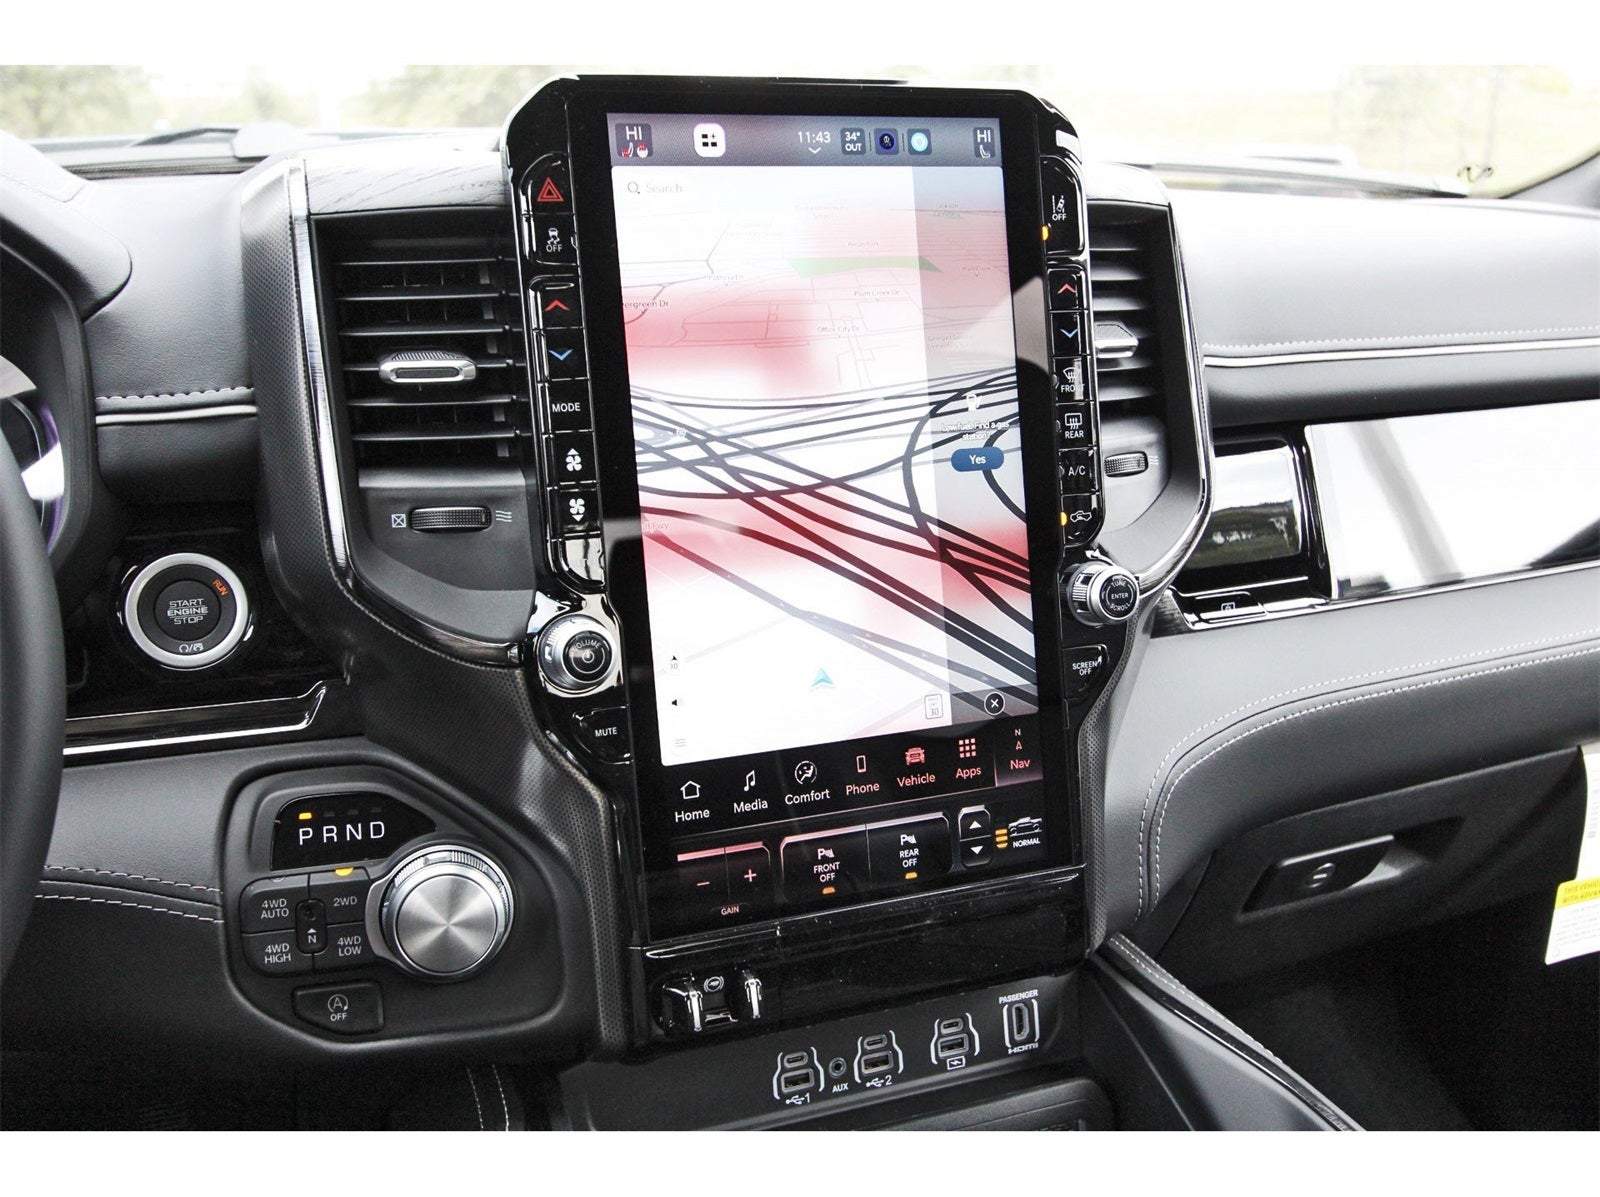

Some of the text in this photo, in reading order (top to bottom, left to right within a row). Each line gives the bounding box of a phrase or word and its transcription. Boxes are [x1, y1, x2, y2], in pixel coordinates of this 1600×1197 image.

[625, 126, 642, 140] HI
[798, 131, 831, 144] 11:43
[976, 129, 991, 142] HI
[845, 143, 862, 152] OUT
[645, 181, 683, 193] Search
[1052, 213, 1067, 221] OFF
[545, 244, 562, 253] OFF
[552, 402, 581, 413] MODE
[1064, 430, 1084, 440] REAR
[969, 454, 986, 464] Yes
[1068, 465, 1086, 476] A/C
[212, 579, 229, 596] RUN
[1111, 592, 1128, 600] ENTER
[169, 598, 204, 608] START
[167, 606, 208, 617] ENGINE
[173, 616, 204, 625] STOP
[1072, 660, 1098, 670] SCREEN
[1079, 668, 1092, 676] OFF
[595, 727, 617, 737] MUTE
[1014, 728, 1021, 736] N
[1010, 759, 1031, 770] Nav
[955, 767, 982, 779] Apps
[897, 773, 936, 787] Vehicle
[846, 782, 880, 796] Phone
[784, 788, 830, 805] Comfort
[733, 798, 769, 813] Media
[675, 809, 710, 822] Home
[299, 821, 385, 845] P R N D
[1012, 837, 1041, 848] NORMAL
[899, 848, 919, 859] REAR
[813, 861, 840, 874] FRONT
[902, 858, 917, 868] OFF
[819, 872, 836, 882] OFF
[261, 898, 287, 909] 4WD
[333, 896, 358, 906] 2WD
[261, 908, 289, 919] AUTO
[720, 904, 740, 915] GAIN
[308, 935, 317, 944] N
[337, 936, 361, 946] 4WD
[265, 943, 290, 954] 4WD
[338, 946, 362, 957] LOW
[264, 953, 291, 964] HIGH
[999, 989, 1039, 1004] PASSENGER
[330, 1012, 347, 1022] OFF
[885, 1075, 893, 1086] 2
[832, 1082, 849, 1093] AUX
[805, 1092, 810, 1103] 1
